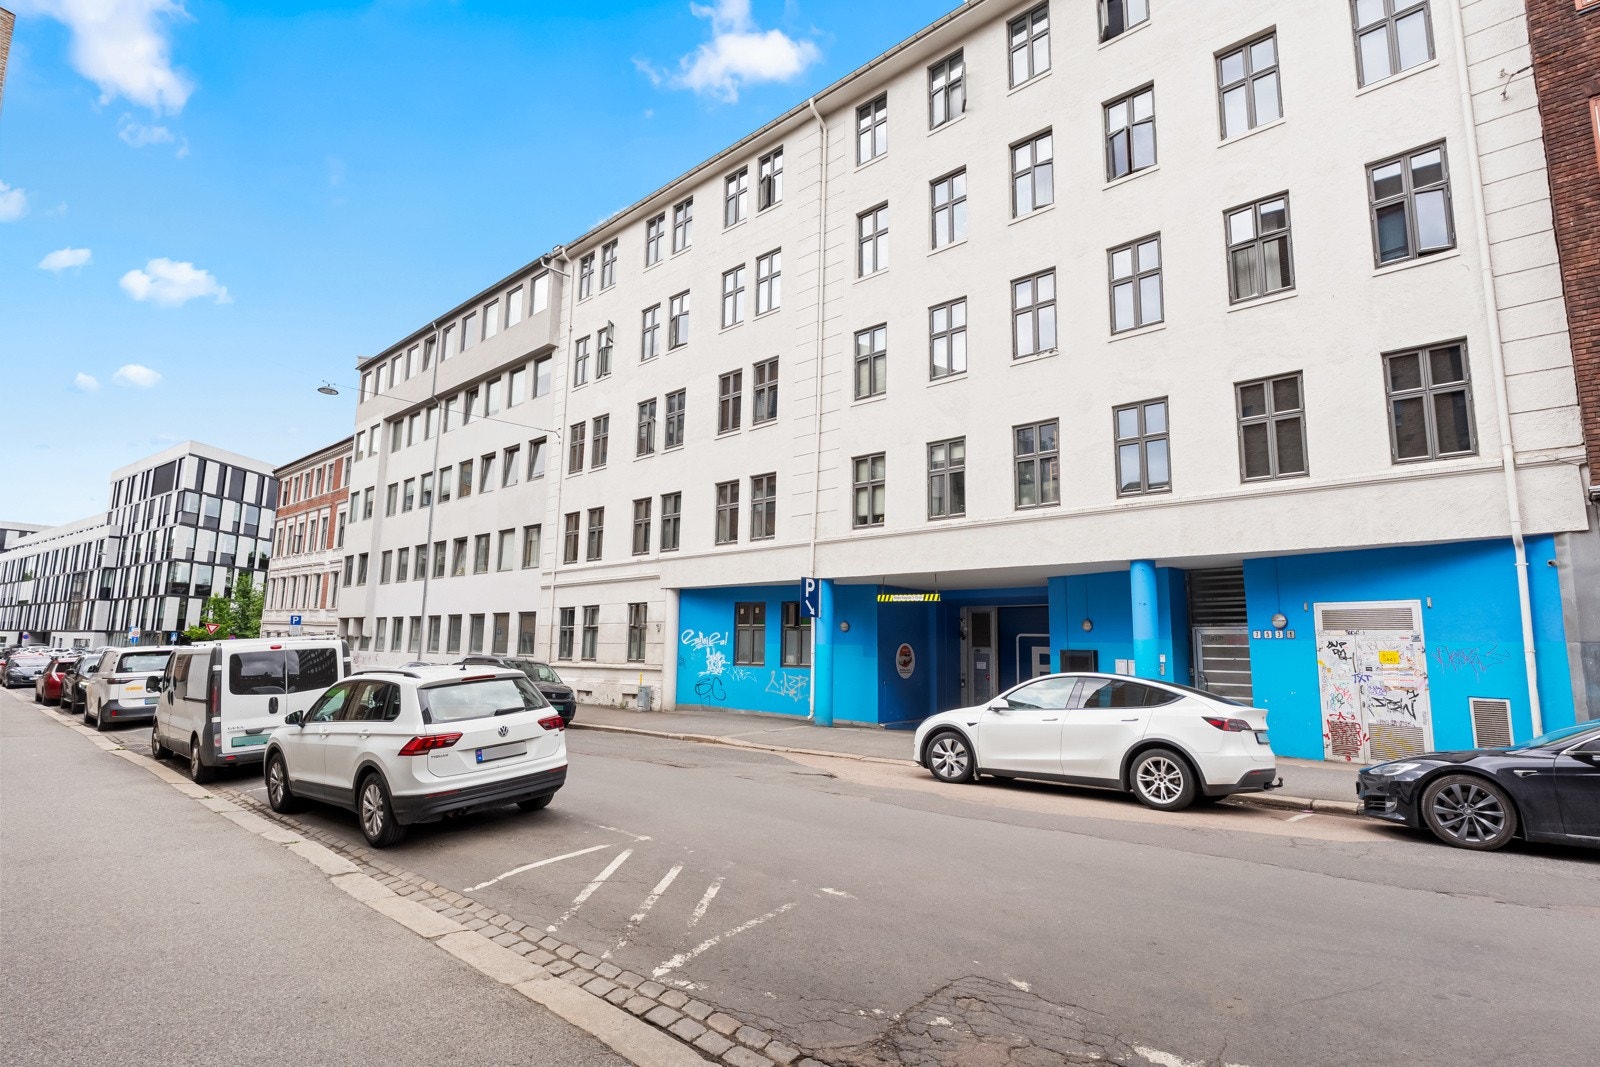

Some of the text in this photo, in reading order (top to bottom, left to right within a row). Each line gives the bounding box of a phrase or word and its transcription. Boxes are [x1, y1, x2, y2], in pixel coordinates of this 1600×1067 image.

[805, 578, 815, 598] P
[292, 616, 300, 625] P
[1352, 673, 1372, 683] TXT
